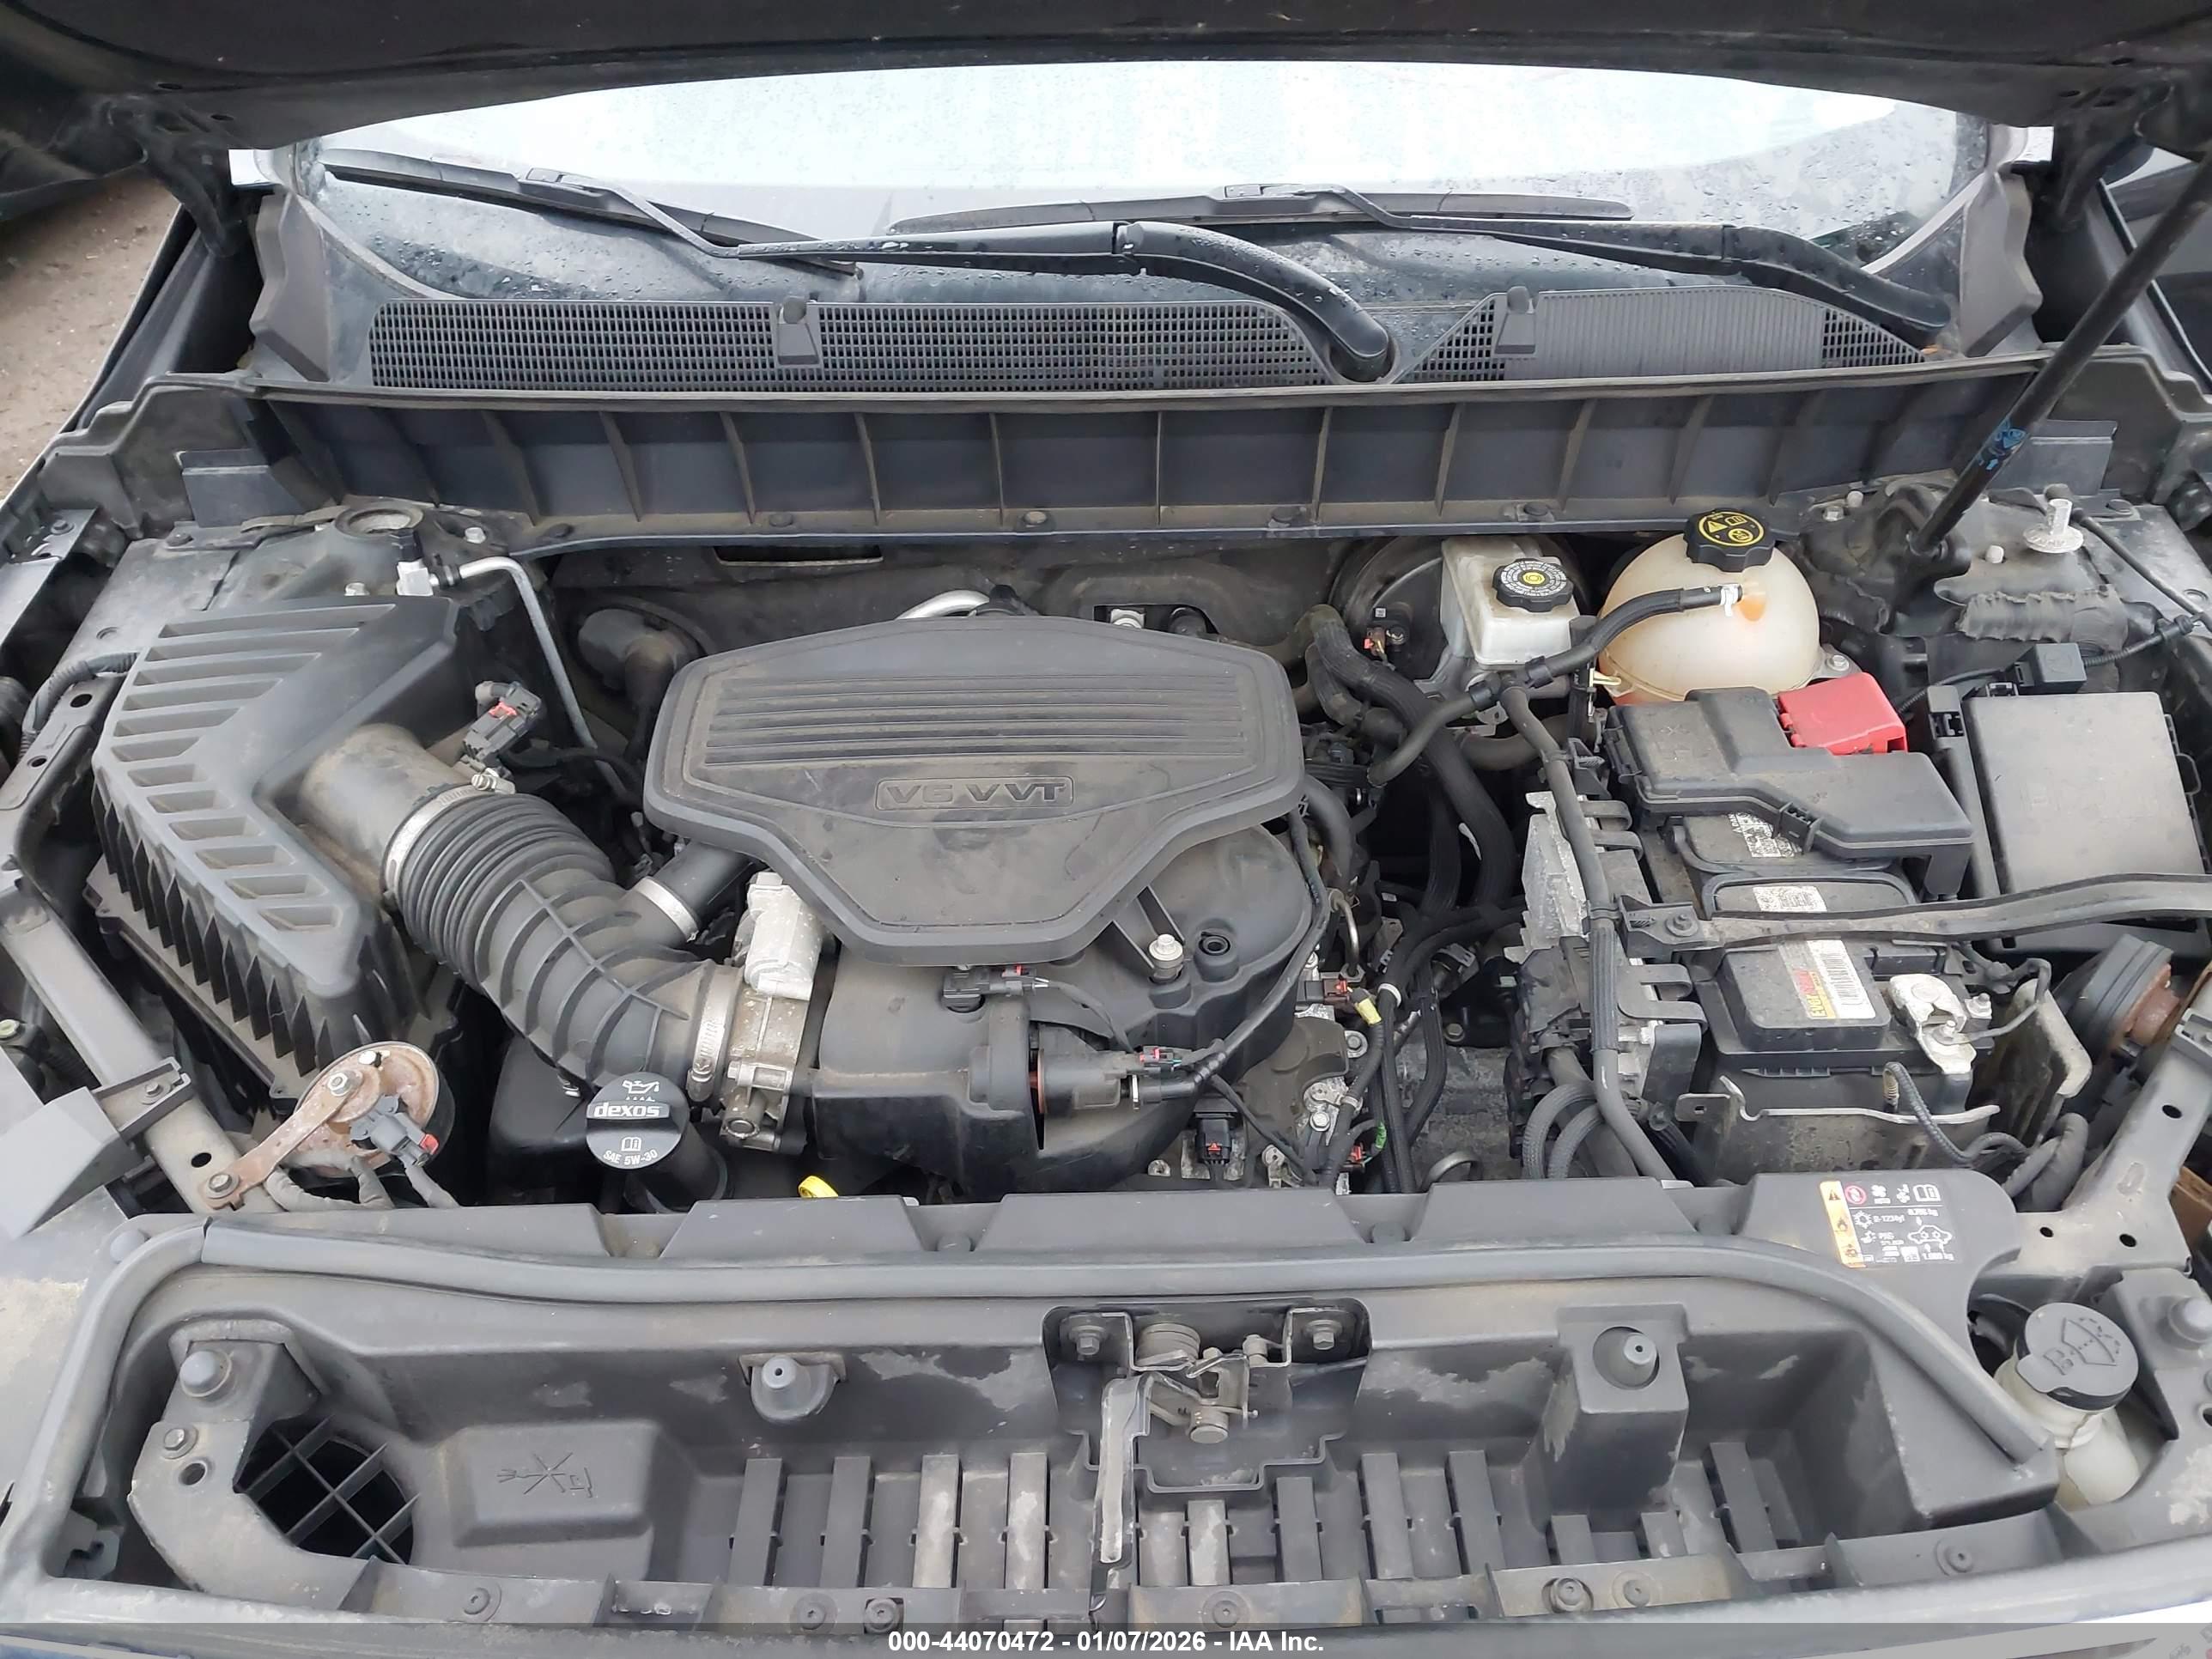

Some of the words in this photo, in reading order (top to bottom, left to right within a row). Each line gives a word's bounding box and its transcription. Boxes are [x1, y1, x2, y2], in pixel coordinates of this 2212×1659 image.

[886, 783, 953, 804] V6
[592, 1102, 660, 1118] dexos
[603, 1150, 622, 1164] SAE
[623, 1149, 658, 1165] 5W-30
